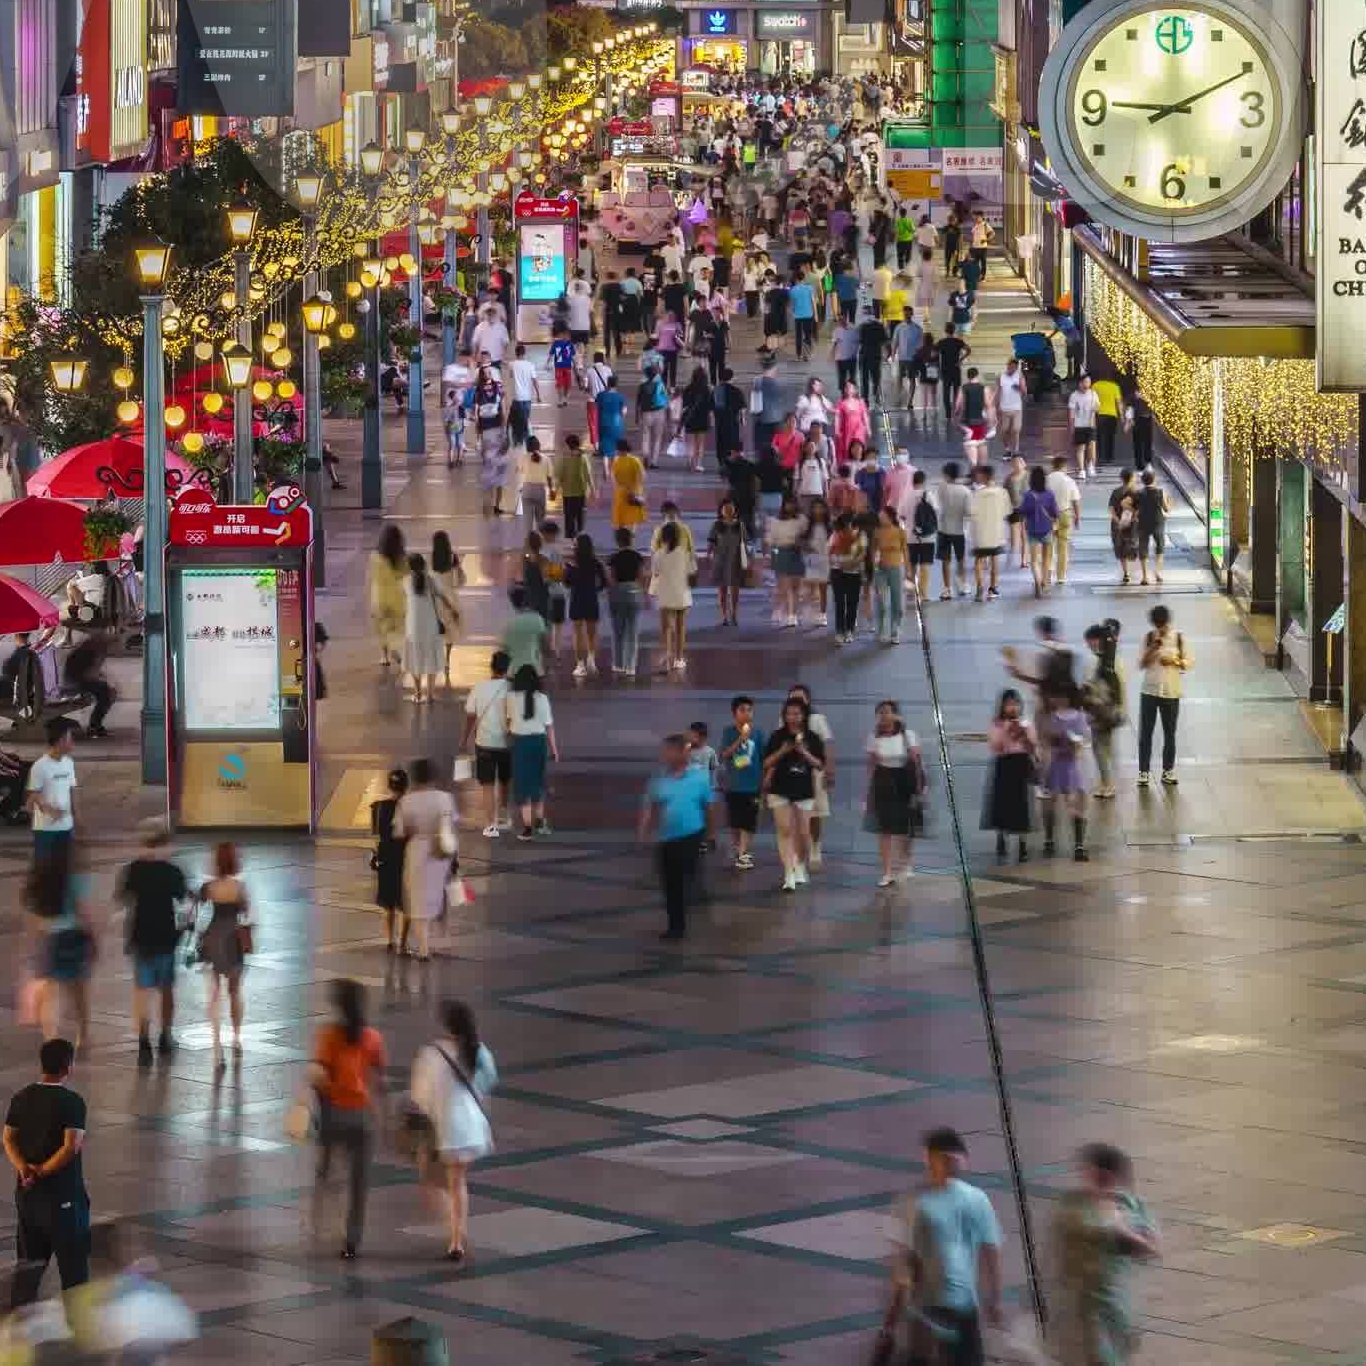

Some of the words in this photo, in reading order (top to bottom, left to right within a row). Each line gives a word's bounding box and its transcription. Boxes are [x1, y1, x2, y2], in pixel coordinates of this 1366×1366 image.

[1081, 89, 1107, 127] 9
[1239, 91, 1266, 129] 3
[1158, 164, 1187, 202] 6
